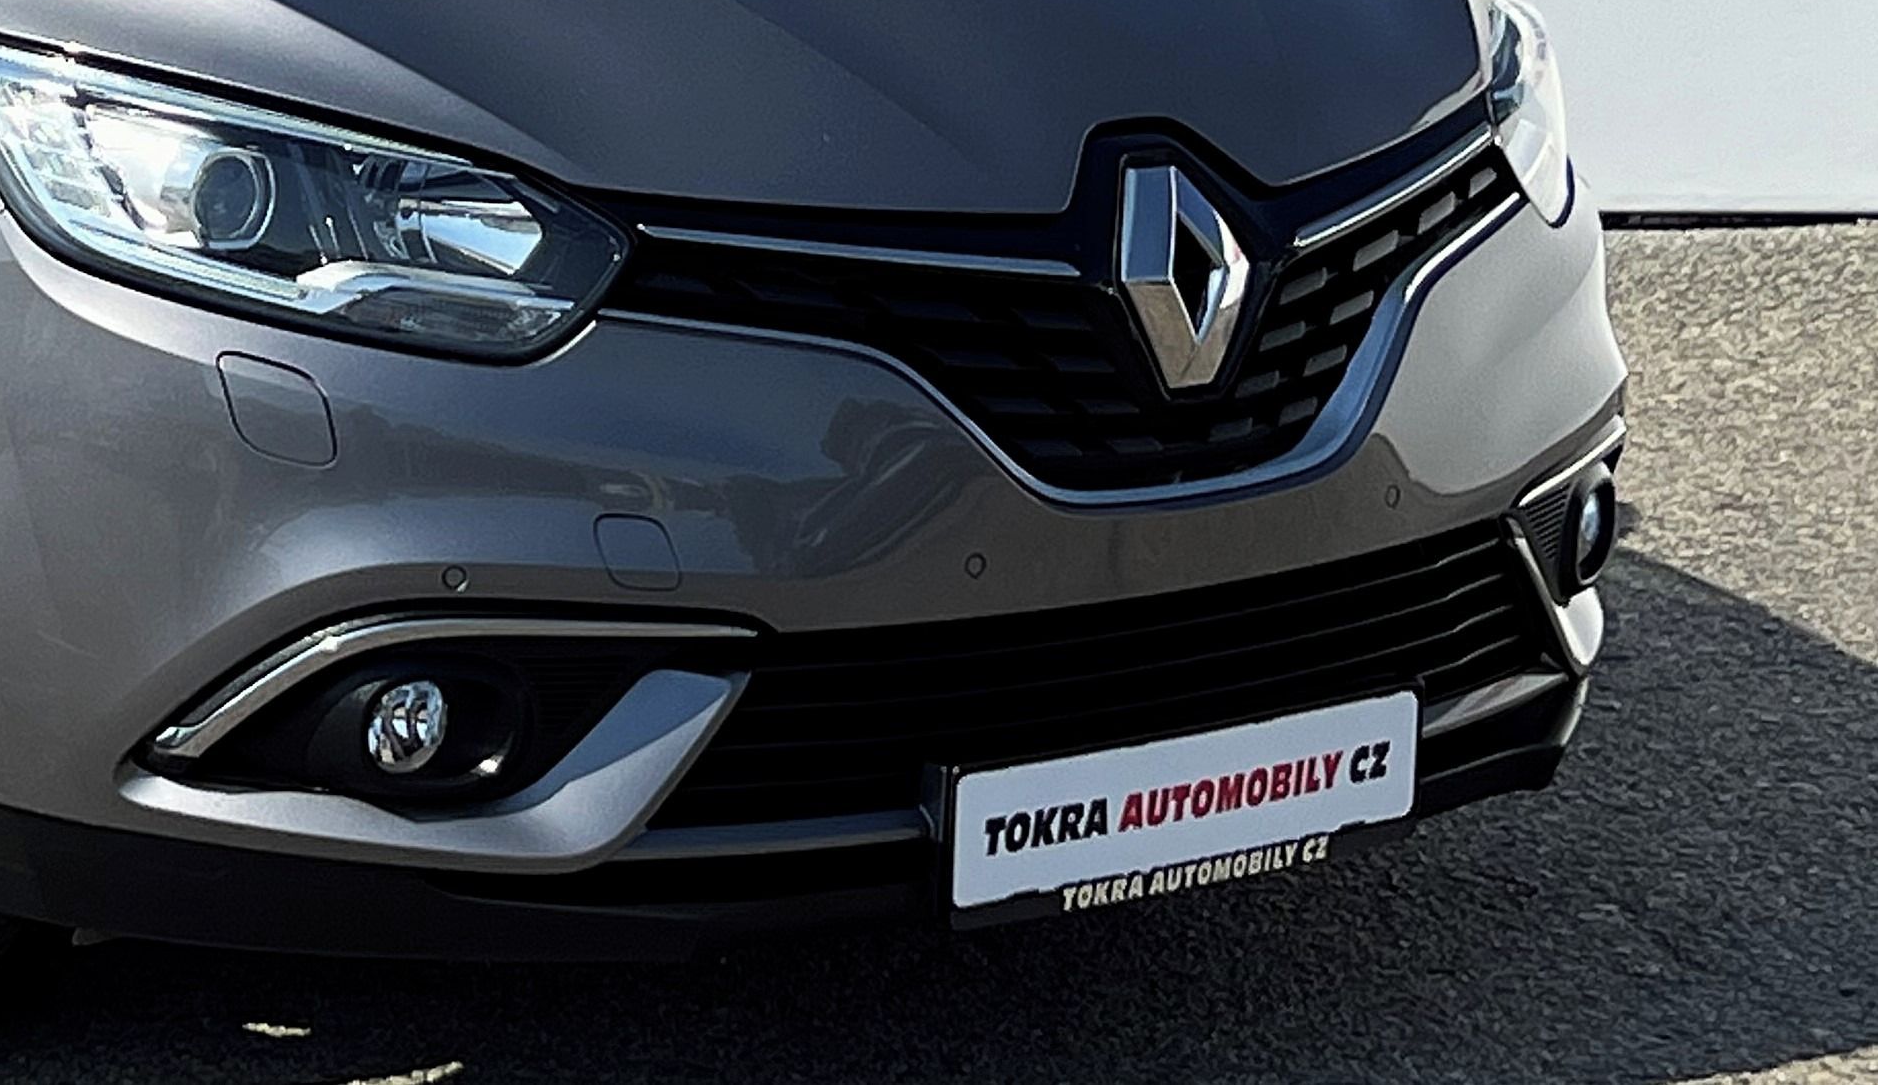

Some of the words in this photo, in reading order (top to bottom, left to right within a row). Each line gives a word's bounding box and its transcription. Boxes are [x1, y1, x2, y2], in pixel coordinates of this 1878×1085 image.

[984, 797, 1108, 857] TOKRA
[1117, 750, 1344, 833] AUTOMOBILY
[1348, 740, 1391, 784] CZ
[1062, 874, 1144, 912] TOKRA
[1148, 841, 1299, 896] AUTOMOBILY
[1302, 834, 1330, 863] CZ
